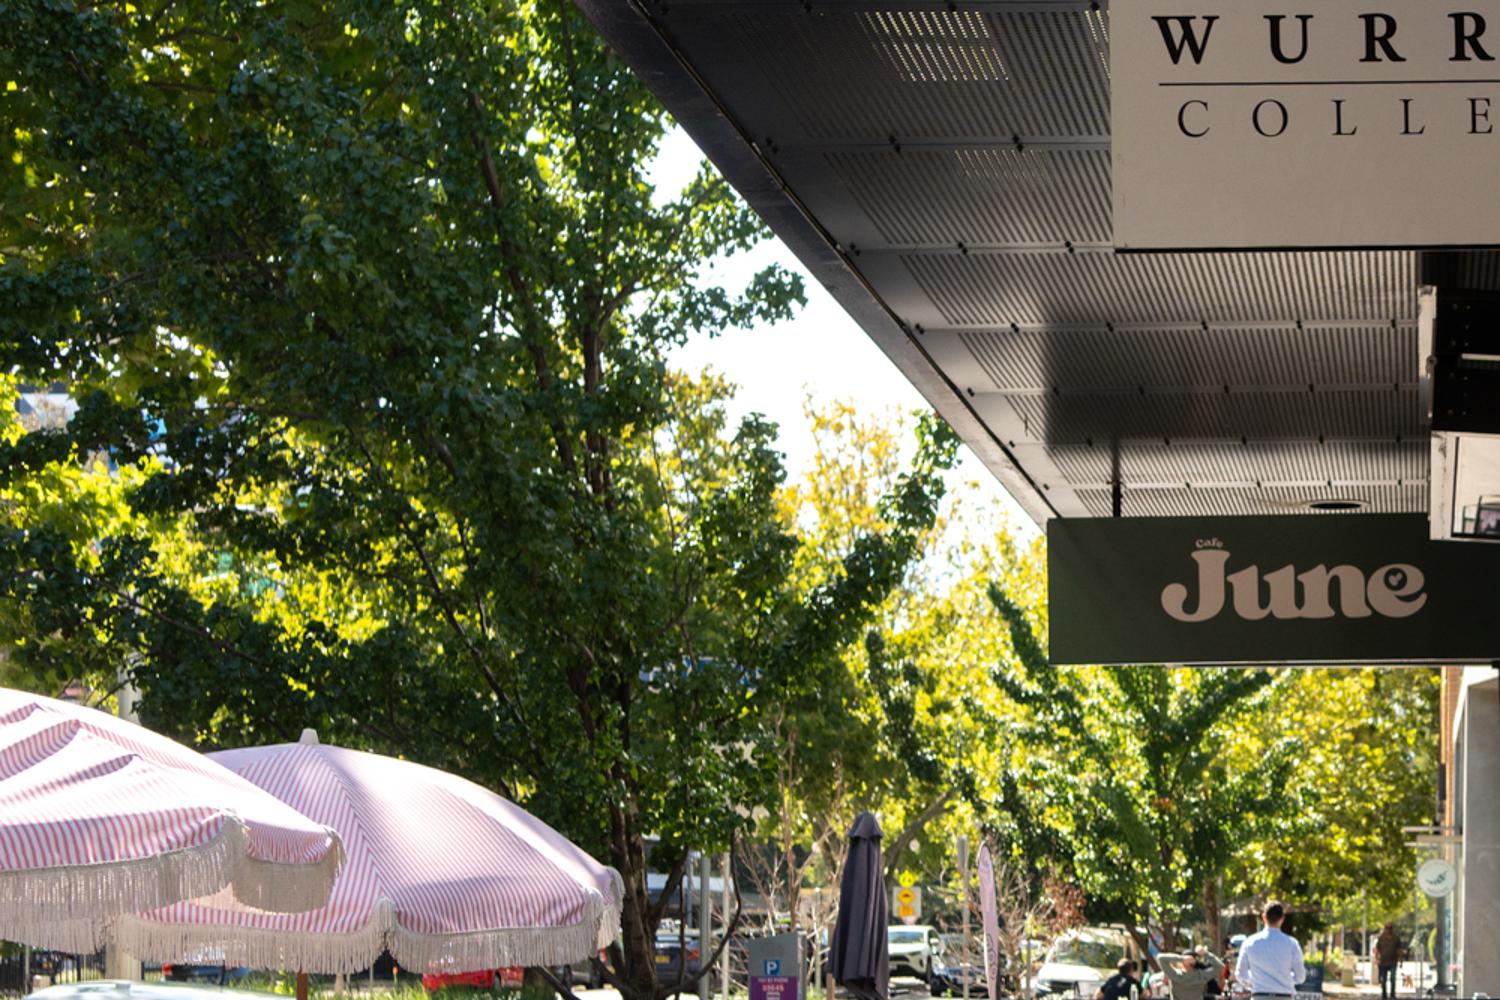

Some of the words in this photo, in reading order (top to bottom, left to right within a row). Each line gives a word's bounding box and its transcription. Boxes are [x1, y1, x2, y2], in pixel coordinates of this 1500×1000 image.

[1196, 538, 1224, 548] Cafe
[1160, 549, 1428, 622] June
[767, 961, 777, 975] P
